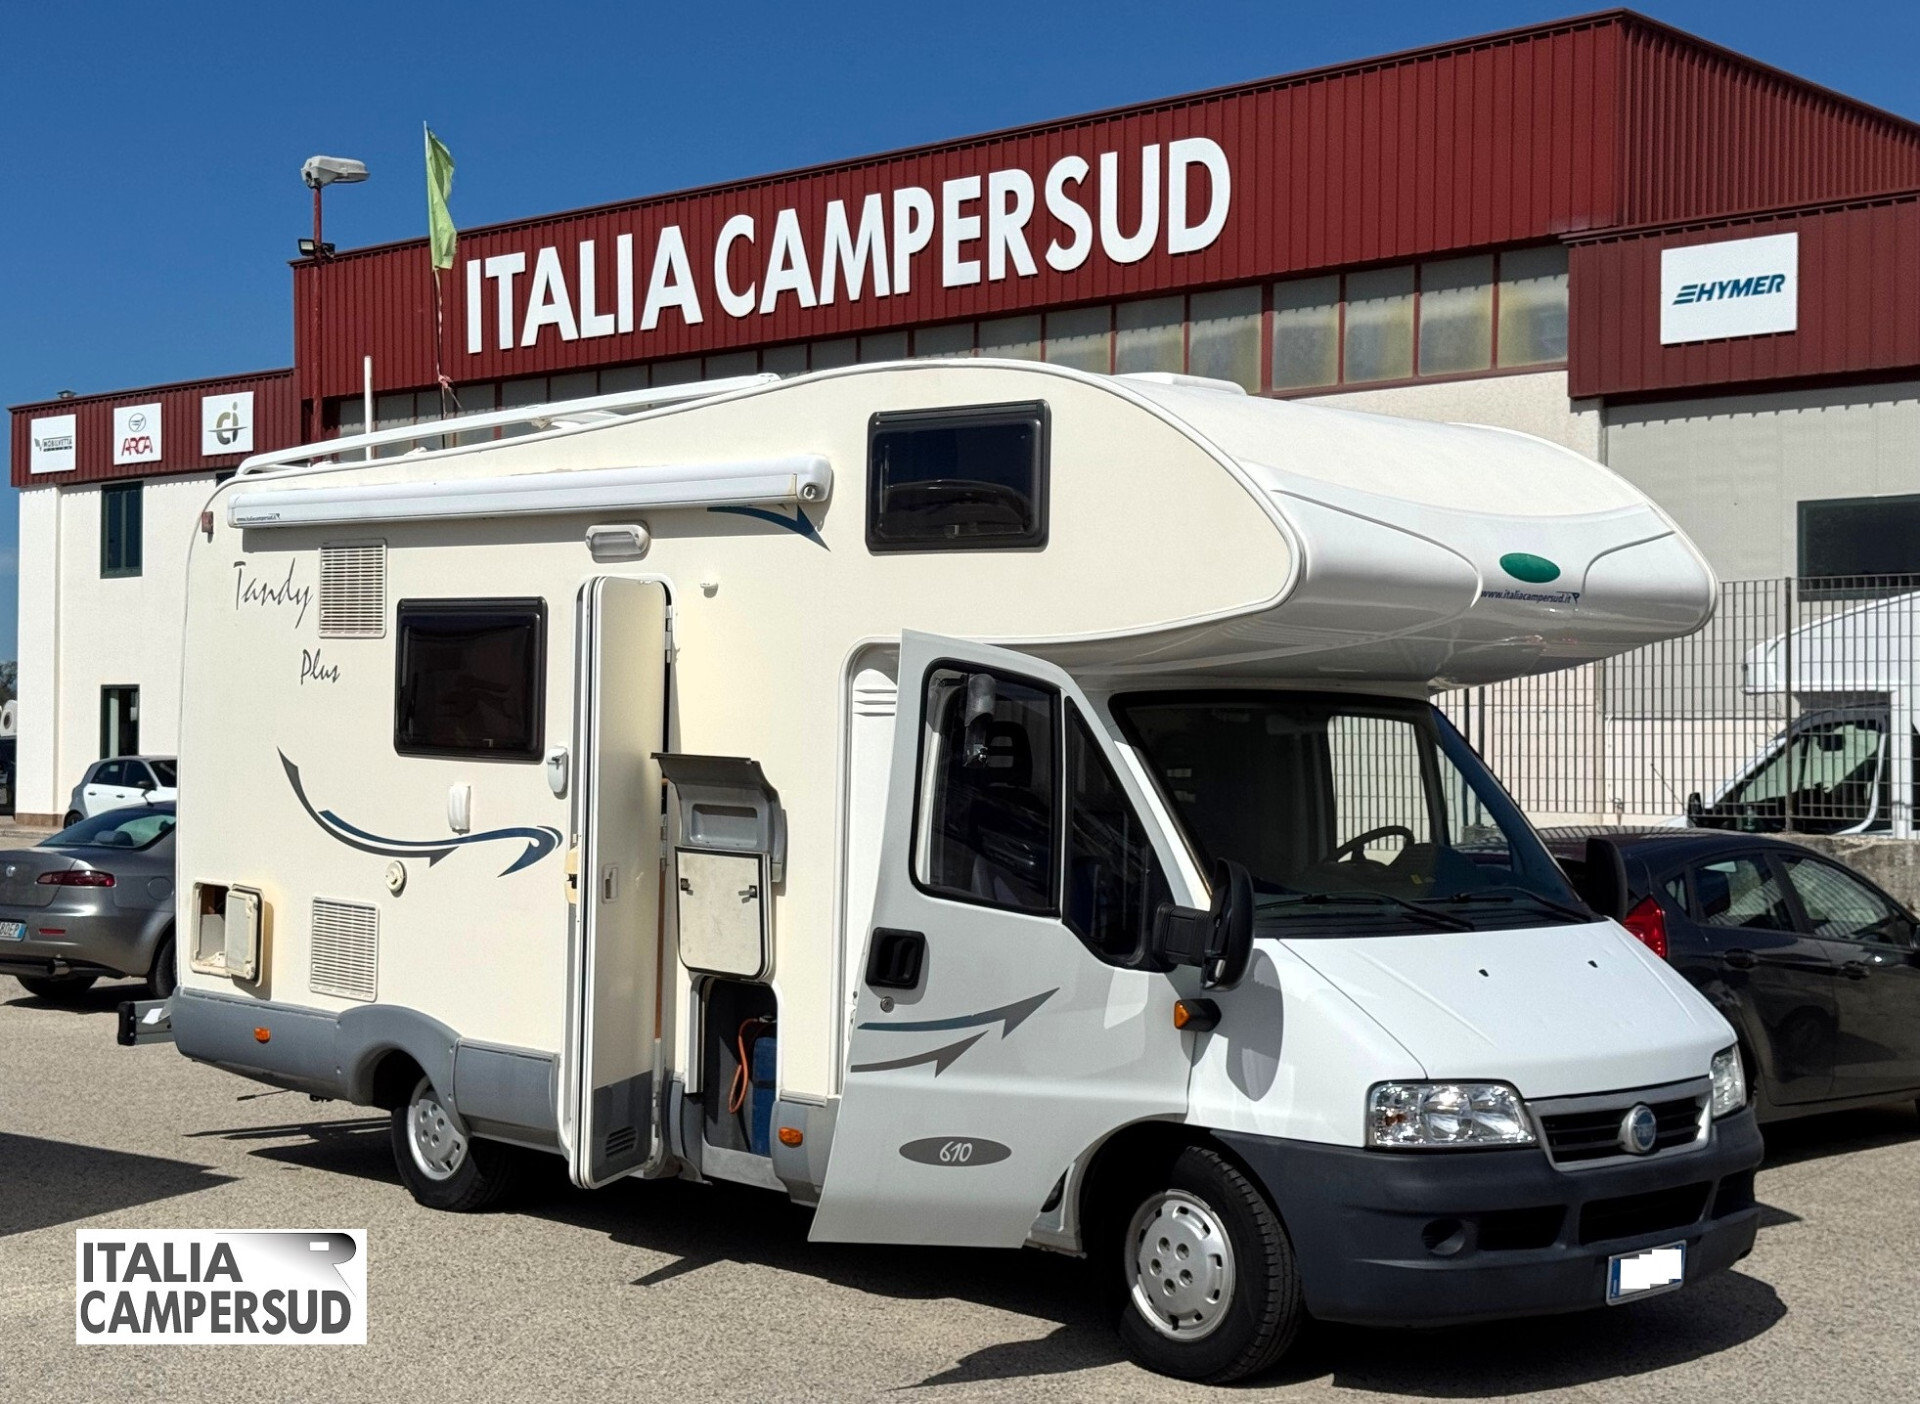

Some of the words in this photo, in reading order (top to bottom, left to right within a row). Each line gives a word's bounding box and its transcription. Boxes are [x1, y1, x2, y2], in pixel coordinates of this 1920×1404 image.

[465, 224, 704, 354] ITALIA
[713, 137, 1232, 319] CAMPERSUD
[1695, 273, 1786, 303] HYMER
[121, 435, 154, 457] ARCA
[233, 557, 314, 630] Tandy
[300, 648, 341, 686] Plus
[939, 1140, 973, 1163] 610
